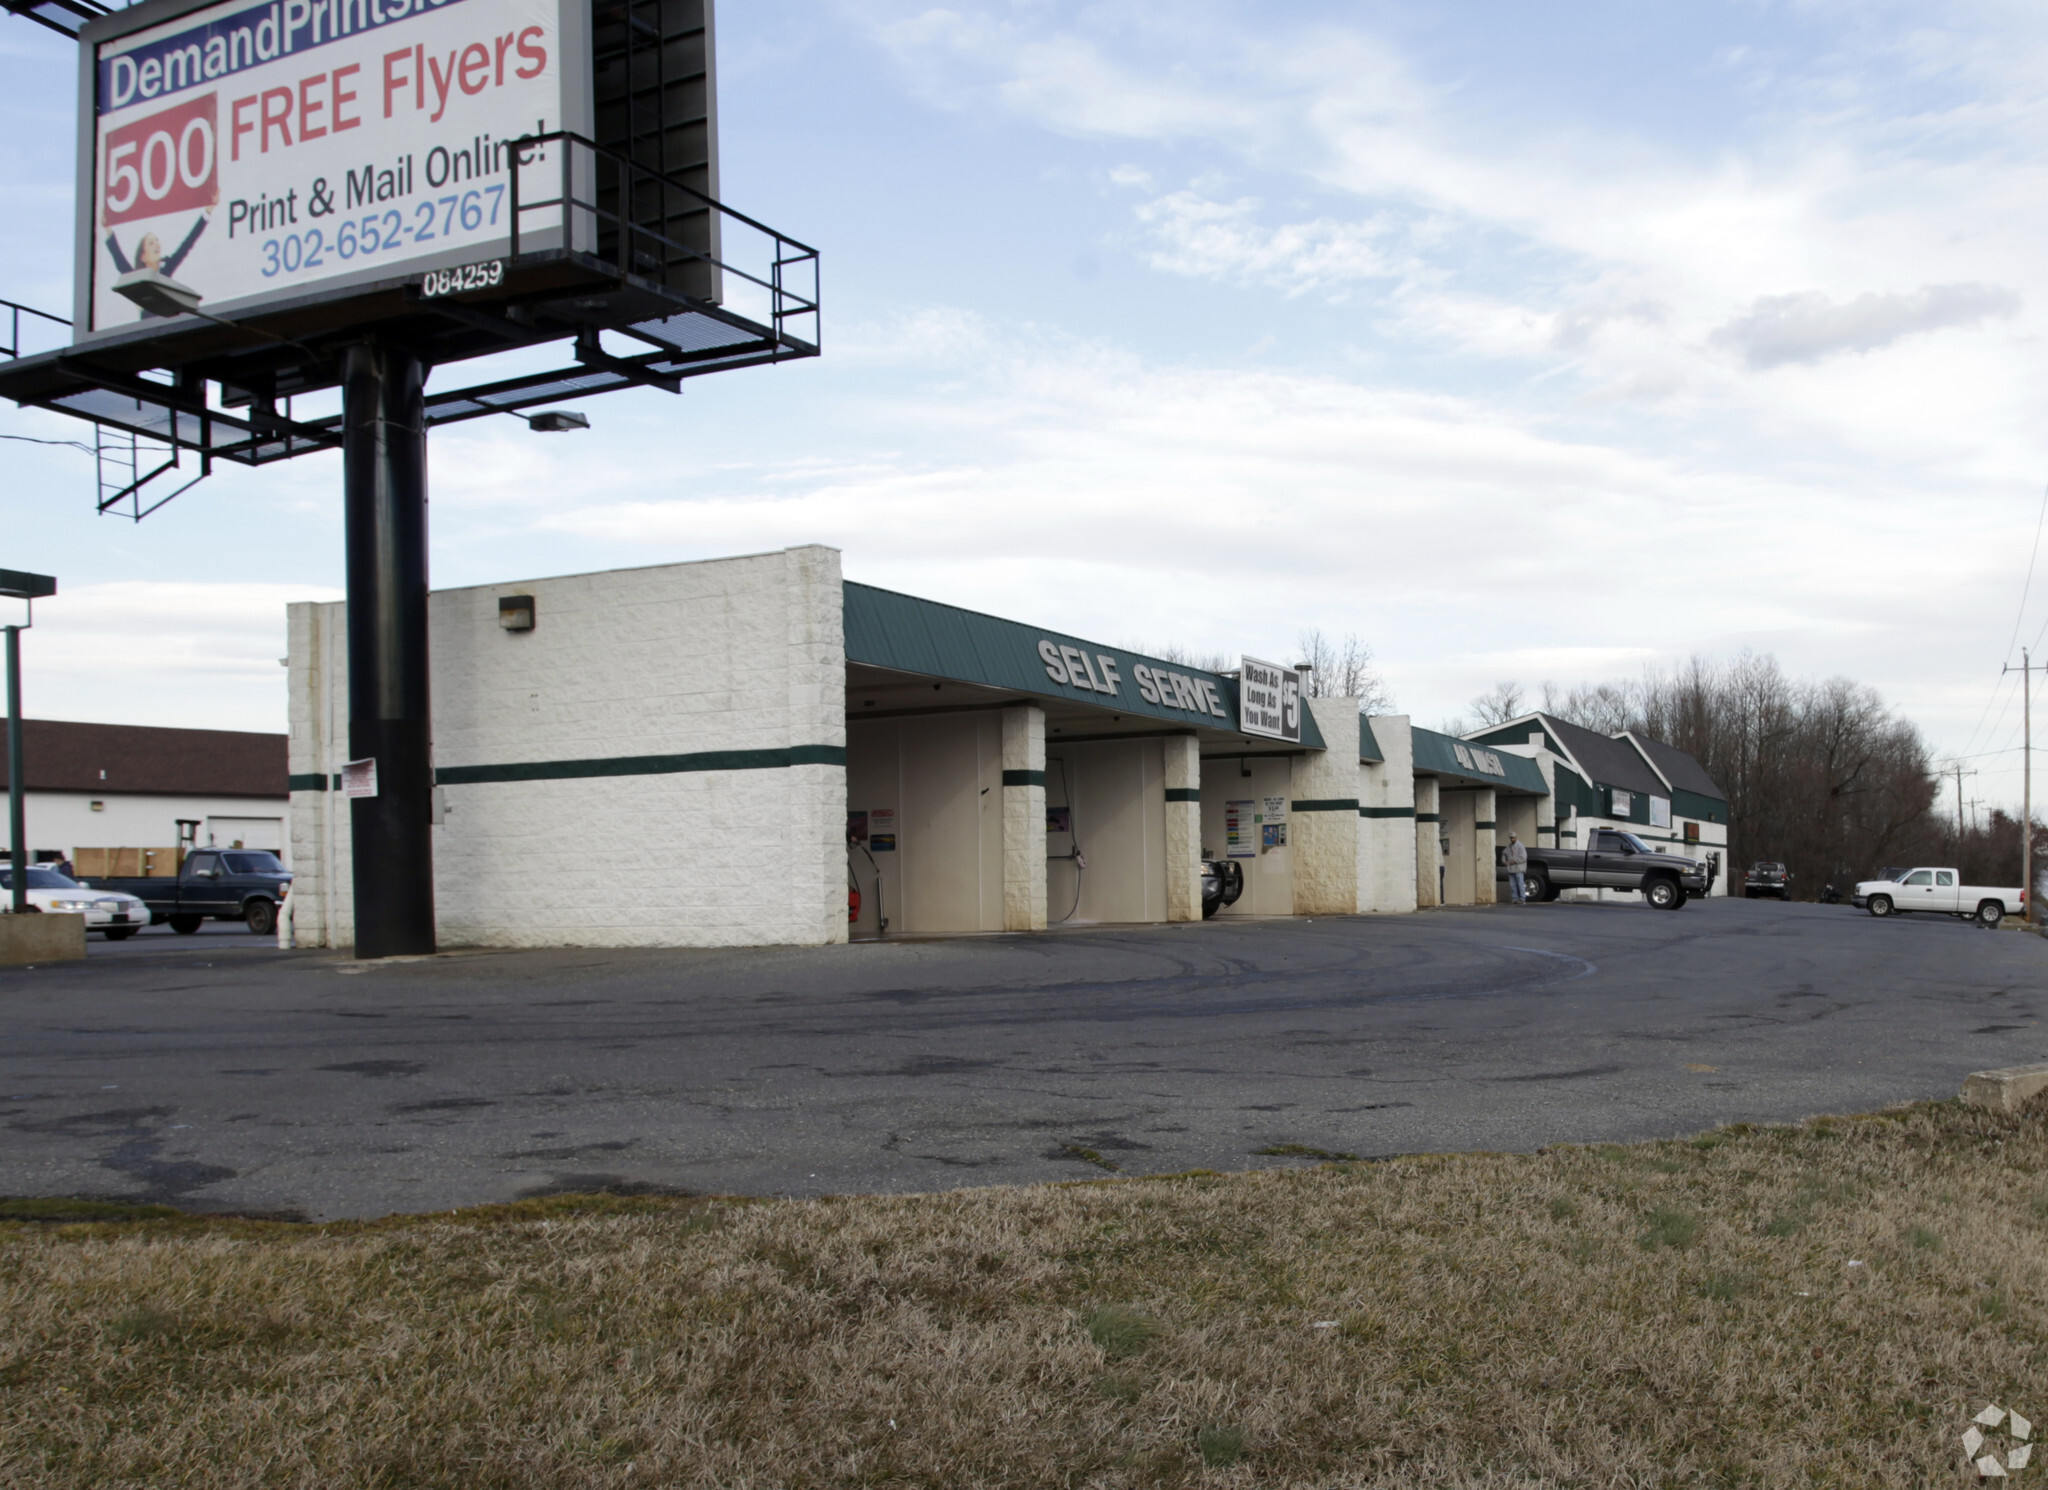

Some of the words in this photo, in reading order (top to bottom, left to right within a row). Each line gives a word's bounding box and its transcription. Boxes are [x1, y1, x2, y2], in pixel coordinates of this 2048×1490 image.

[231, 62, 361, 162] FREE
[383, 25, 548, 123] Flyers
[106, 117, 214, 214] 500
[229, 187, 298, 239] Print
[308, 177, 335, 218] &
[346, 154, 412, 210] Mail
[425, 119, 545, 188] Online!
[261, 183, 506, 278] 302-652-2767
[423, 260, 504, 297] 084259
[1037, 639, 1121, 696] SELF
[1133, 663, 1227, 718] SERVE
[1245, 664, 1268, 686] Wash
[1269, 671, 1279, 689] As
[1247, 686, 1266, 708] Long
[1267, 692, 1277, 709] As
[1282, 680, 1298, 729] $5
[1244, 706, 1259, 726] You
[1260, 710, 1280, 731] Want
